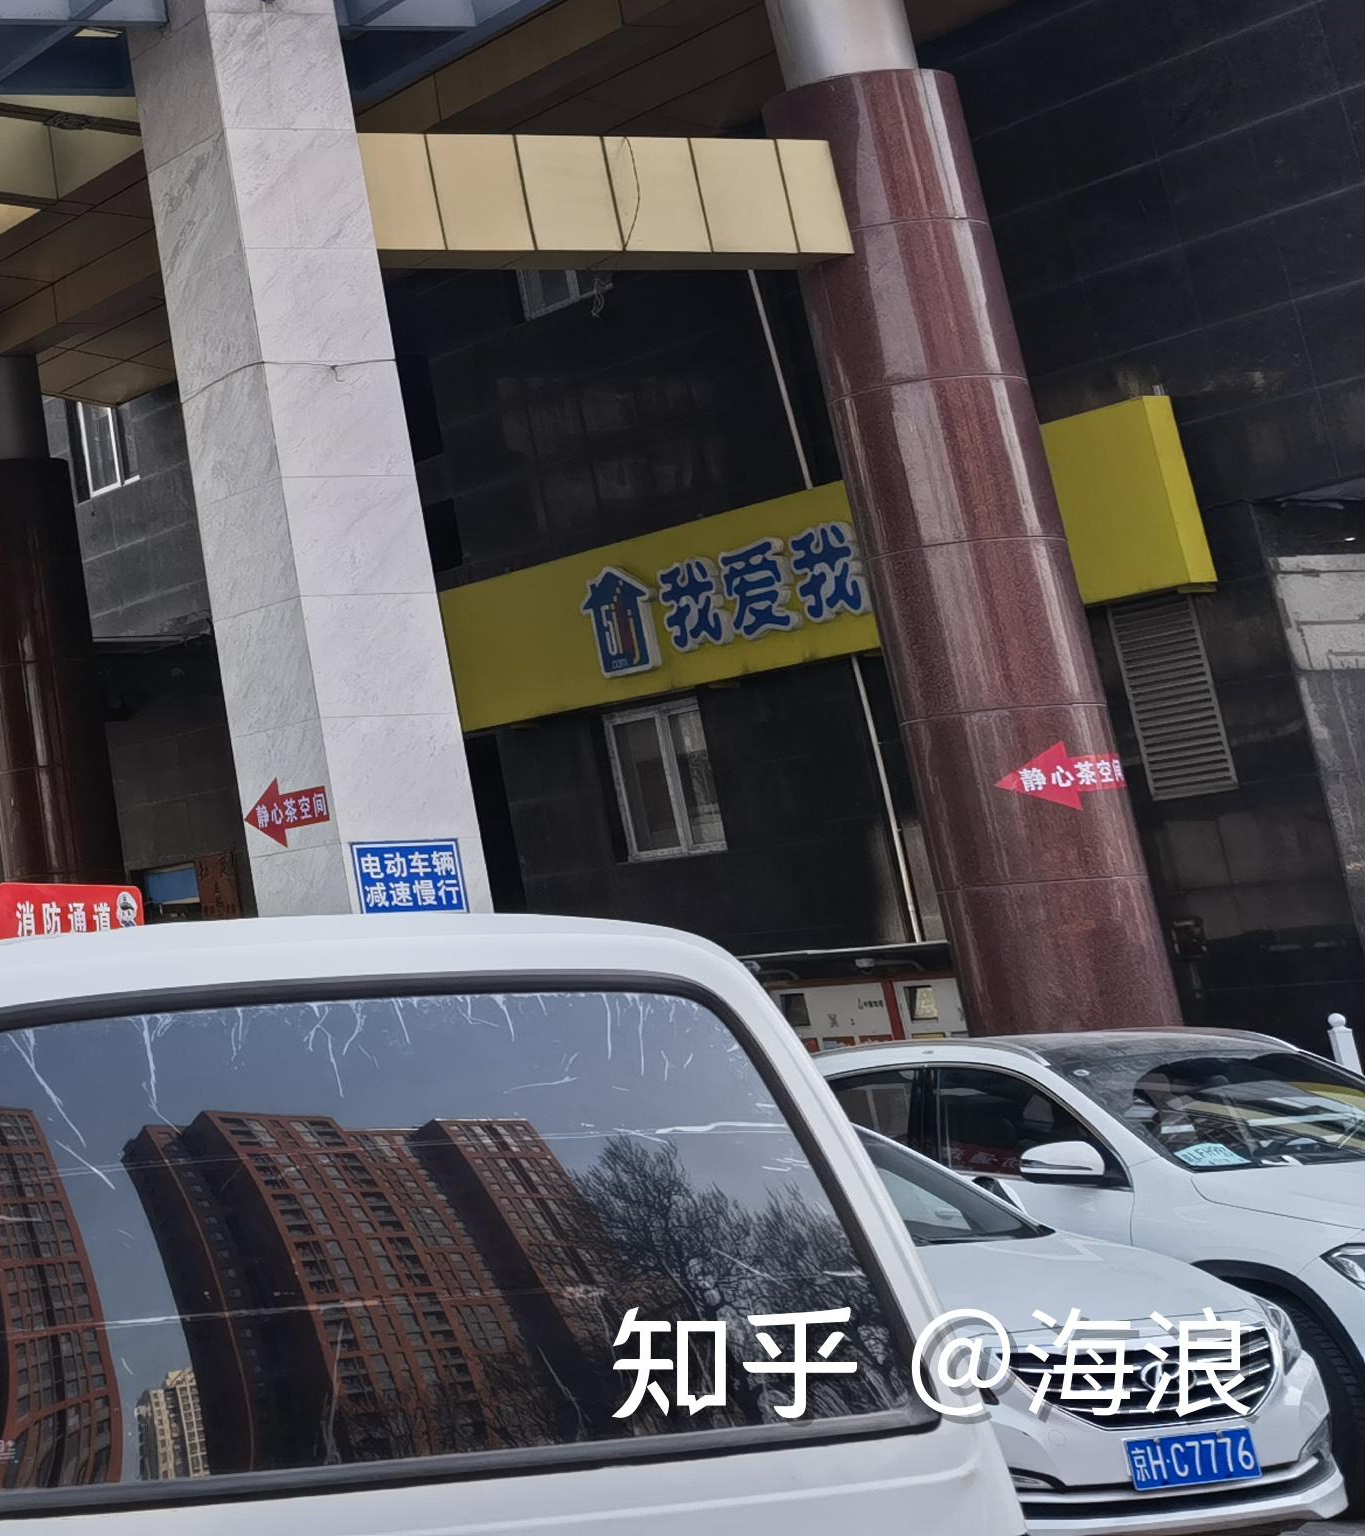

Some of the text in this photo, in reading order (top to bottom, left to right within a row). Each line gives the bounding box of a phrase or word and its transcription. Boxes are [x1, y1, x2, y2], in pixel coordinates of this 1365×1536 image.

[658, 523, 867, 650] 我爱我
[256, 793, 327, 828] 静心茶空间
[360, 850, 456, 879] 电动车辆
[365, 879, 460, 908] 减速慢行
[16, 901, 111, 937] 消防通道
